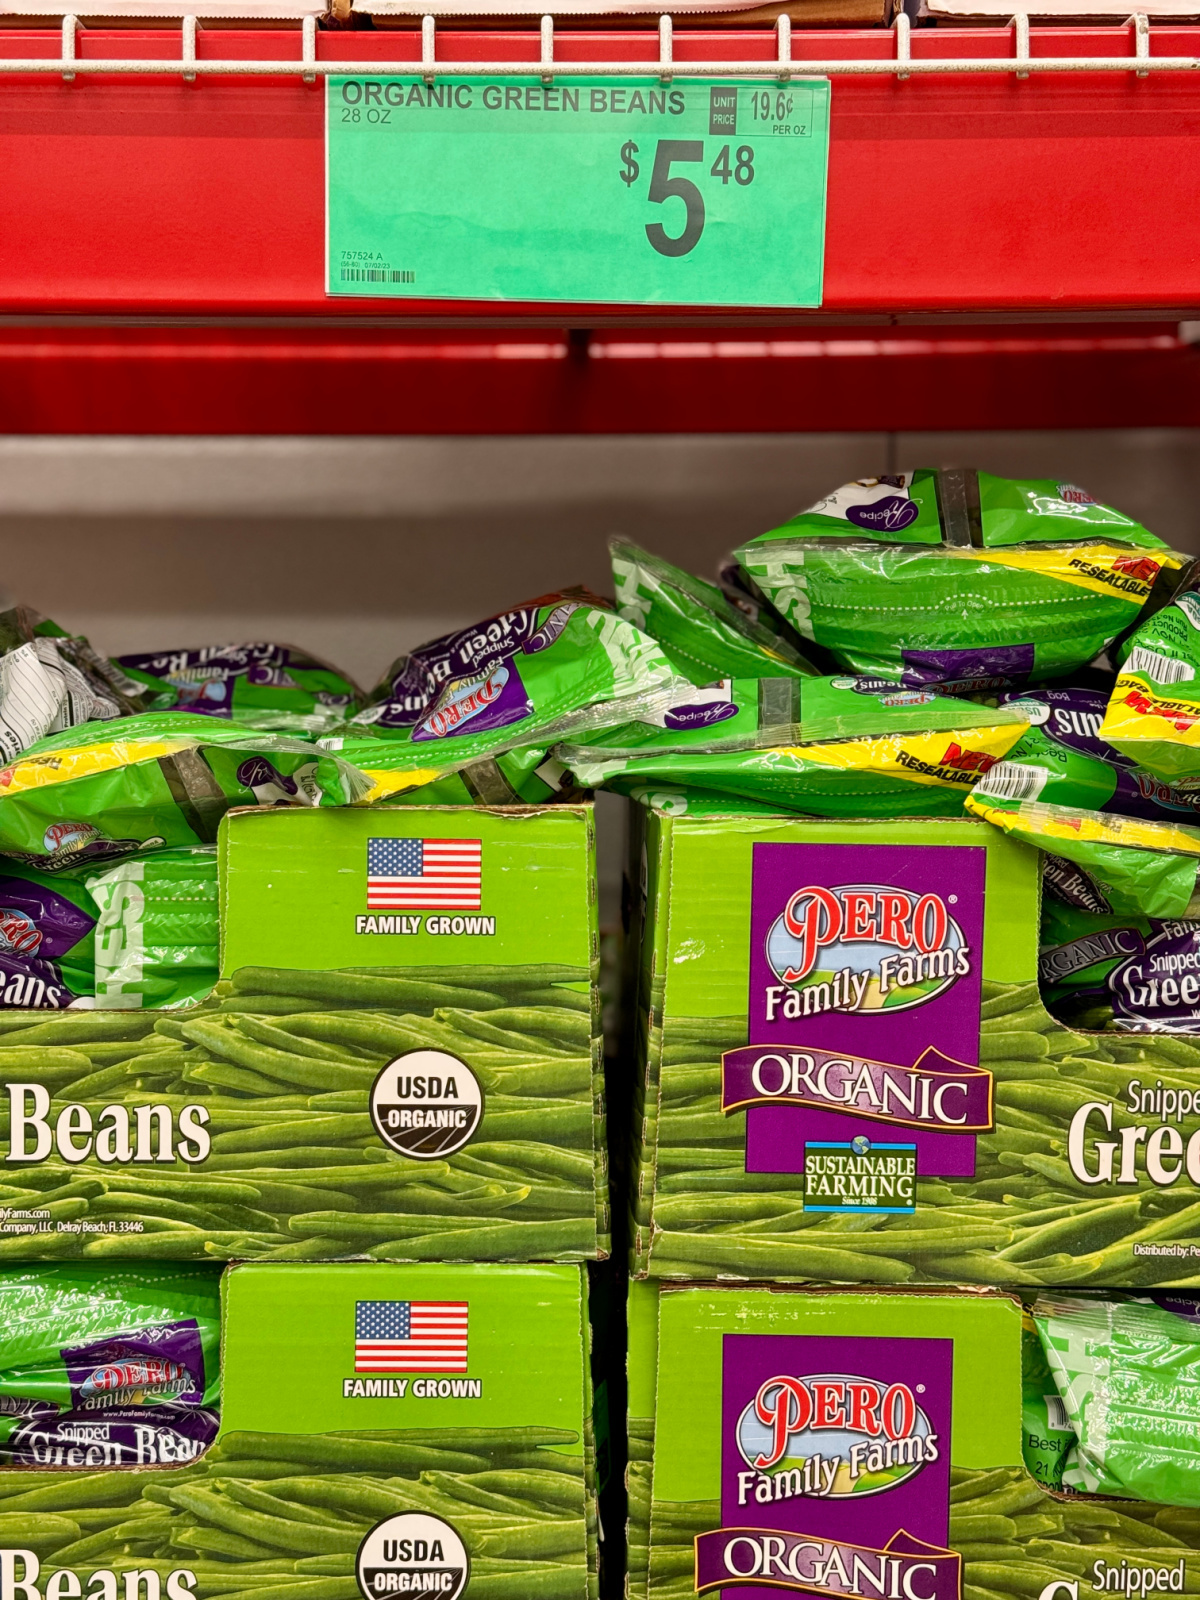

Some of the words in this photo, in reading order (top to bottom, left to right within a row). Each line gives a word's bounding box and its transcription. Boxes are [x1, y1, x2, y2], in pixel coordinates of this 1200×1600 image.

[341, 80, 473, 110] ORGANIC
[482, 84, 580, 113] GREEN
[590, 89, 686, 116] BEANS
[713, 96, 735, 107] UNIT
[751, 90, 794, 121] 19.6¢
[341, 108, 362, 124] 28
[366, 108, 392, 125] OZ
[712, 114, 735, 125] PRICE
[773, 124, 791, 135] PER
[793, 125, 806, 135] OZ
[341, 250, 374, 261] 757524
[376, 252, 384, 261] A
[1068, 558, 1152, 598] RESEALABLE
[470, 635, 515, 668] Snipped
[429, 680, 503, 737] PERO
[895, 749, 983, 786] RESEALABLE
[46, 823, 94, 851] PERO
[355, 915, 422, 935] FAMILY
[425, 916, 496, 936] GROWN
[782, 885, 948, 983] PERO
[764, 966, 872, 1022] Family
[879, 946, 971, 994] Farms
[396, 1076, 460, 1100] USDA
[751, 1052, 969, 1126] ORGANIC
[5, 1082, 212, 1164] Beans
[387, 1109, 467, 1129] ORGANIC
[805, 1155, 916, 1176] SUSTAINABLE
[805, 1175, 914, 1198] FARMING
[841, 1196, 861, 1206] Since
[39, 1221, 53, 1232] LLC
[57, 1221, 82, 1235] Delray
[109, 1222, 118, 1233] FL
[119, 1222, 144, 1233] 33446
[1134, 1244, 1176, 1256] Distributed
[343, 1378, 410, 1398] FAMILY
[412, 1379, 482, 1398] GROWN
[57, 1422, 110, 1446] Snipped
[753, 1375, 917, 1469] PERO
[28, 1430, 123, 1467] Green
[134, 1426, 206, 1464] Bean
[1028, 1434, 1061, 1452] Best
[737, 1453, 841, 1506] Family
[849, 1434, 939, 1479] Farms
[1035, 1460, 1049, 1477] 21
[382, 1539, 446, 1563] USDA
[723, 1536, 938, 1600] ORGANIC
[1091, 1558, 1185, 1599] Snipped
[373, 1572, 453, 1592] ORGANIC
